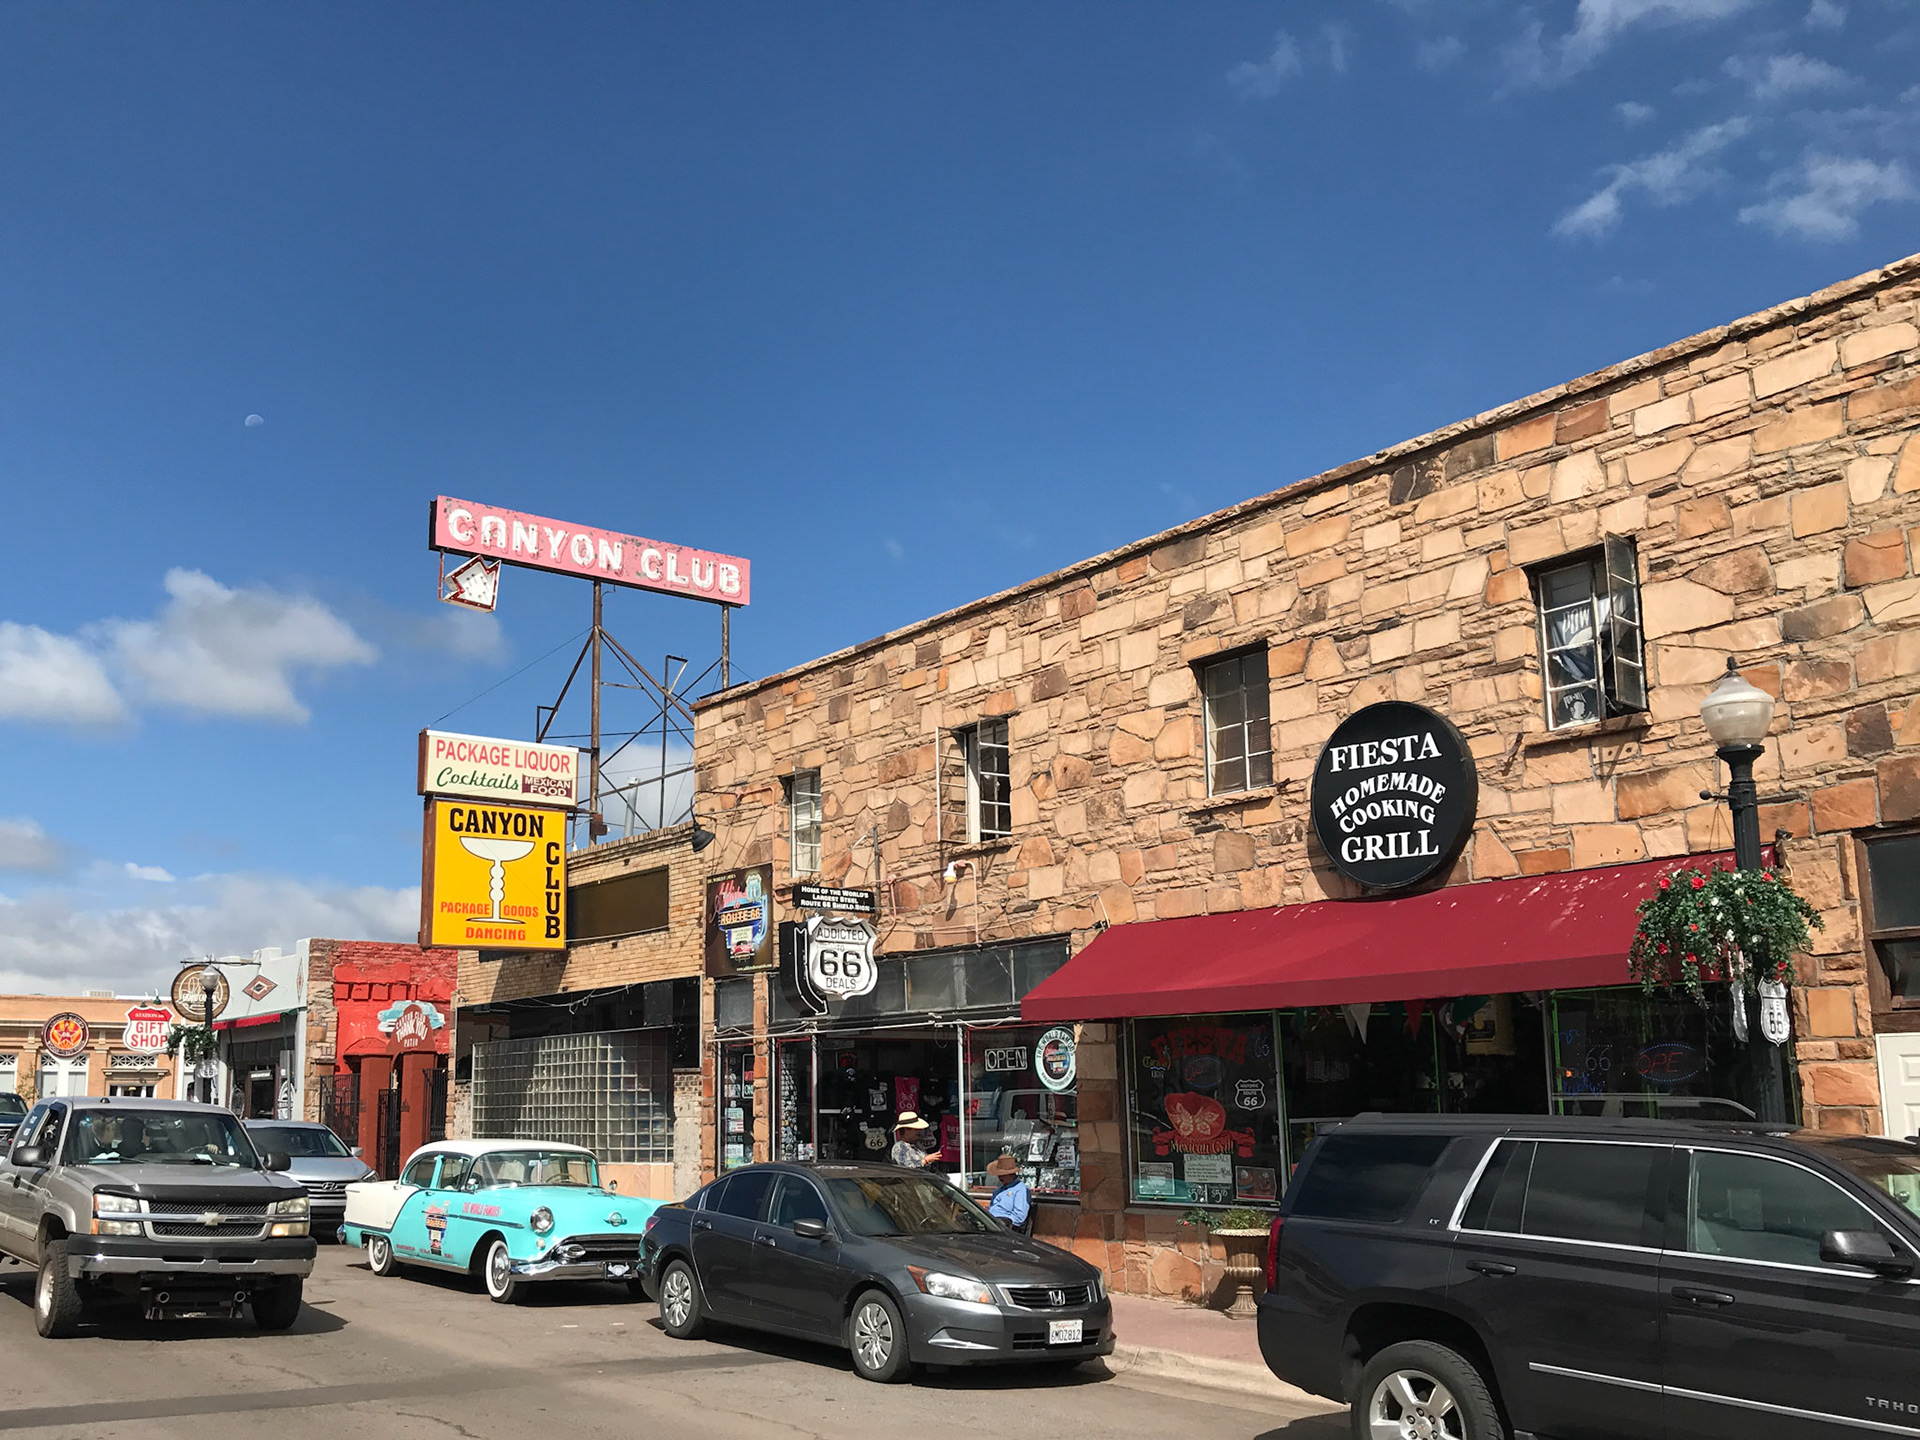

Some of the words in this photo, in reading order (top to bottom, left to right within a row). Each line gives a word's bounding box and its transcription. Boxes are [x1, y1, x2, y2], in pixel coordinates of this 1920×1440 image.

[448, 508, 624, 575] CANYON
[641, 548, 741, 595] CLUB
[436, 739, 511, 767] PACKAGE
[515, 749, 570, 774] LIQUOR
[1330, 732, 1442, 773] FIESTA
[436, 766, 519, 791] Cocktails
[524, 776, 571, 789] MEXICAN
[530, 784, 567, 797] FOOD
[1329, 772, 1446, 819] HOMEMADE
[450, 808, 544, 838] CANYON
[1339, 799, 1436, 834] COOKING
[1341, 829, 1439, 863] GRILL
[545, 842, 561, 939] CLUB
[801, 886, 820, 894] HOME
[842, 889, 869, 899] WORLD'S
[812, 894, 839, 902] LARGEST
[840, 896, 858, 904] STEEL
[440, 901, 490, 915] PACKAGE
[503, 904, 539, 918] GOODS
[800, 899, 822, 907] ROUTE
[832, 901, 853, 910] SHIELD
[720, 910, 749, 925] ROUTE
[750, 908, 761, 921] 66
[465, 927, 526, 941] DANCING
[816, 927, 864, 941] ADDICTED
[820, 949, 862, 977] 66
[825, 977, 857, 989] DEALS
[136, 1022, 164, 1034] GIFT
[396, 1019, 416, 1043] THANK
[416, 1019, 428, 1041] YOU
[1769, 1012, 1783, 1034] 66
[130, 1034, 168, 1047] SHOP
[404, 1038, 419, 1047] PATIO
[1041, 1031, 1058, 1046] WORLD
[1150, 1026, 1248, 1064] FIESTA
[987, 1049, 1026, 1069] OPEN
[1585, 1047, 1611, 1071] 66
[1243, 1097, 1258, 1106] 66
[870, 1139, 883, 1147] 66
[1170, 1141, 1211, 1155] Mexican
[1212, 1140, 1234, 1155] Grill
